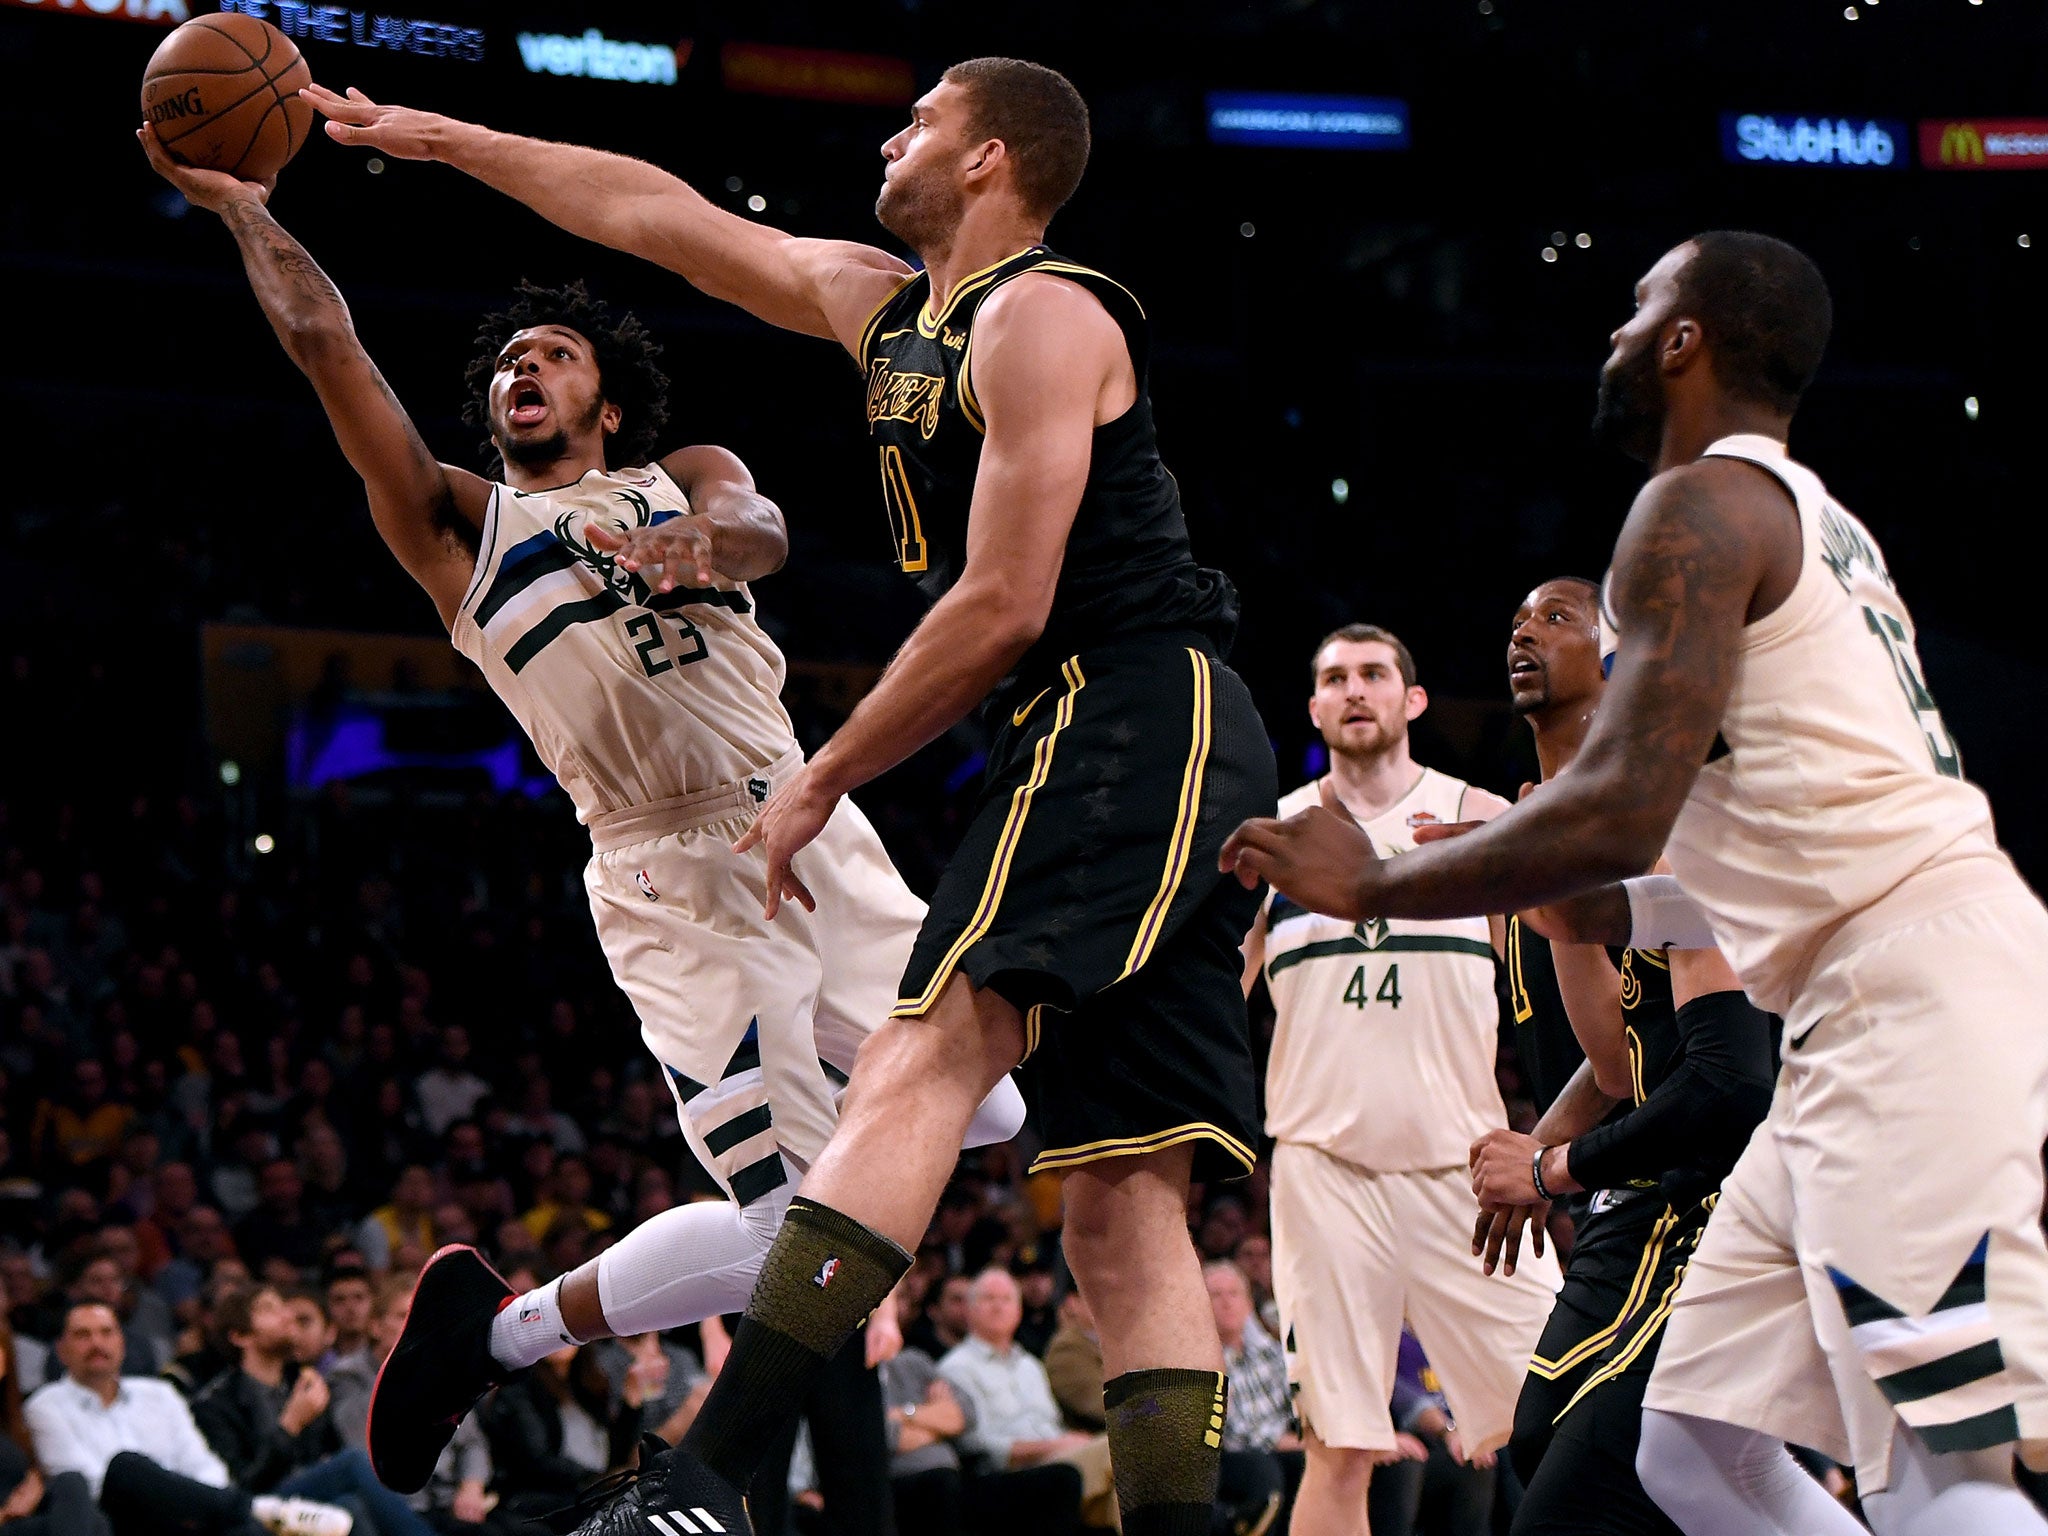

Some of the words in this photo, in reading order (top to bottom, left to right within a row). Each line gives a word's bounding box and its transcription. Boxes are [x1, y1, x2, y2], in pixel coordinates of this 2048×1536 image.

[515, 28, 678, 86] verizon
[1736, 114, 1895, 166] StubHub
[624, 611, 710, 679] 23
[1343, 963, 1402, 1010] 44
[1508, 914, 1534, 1025] 1
